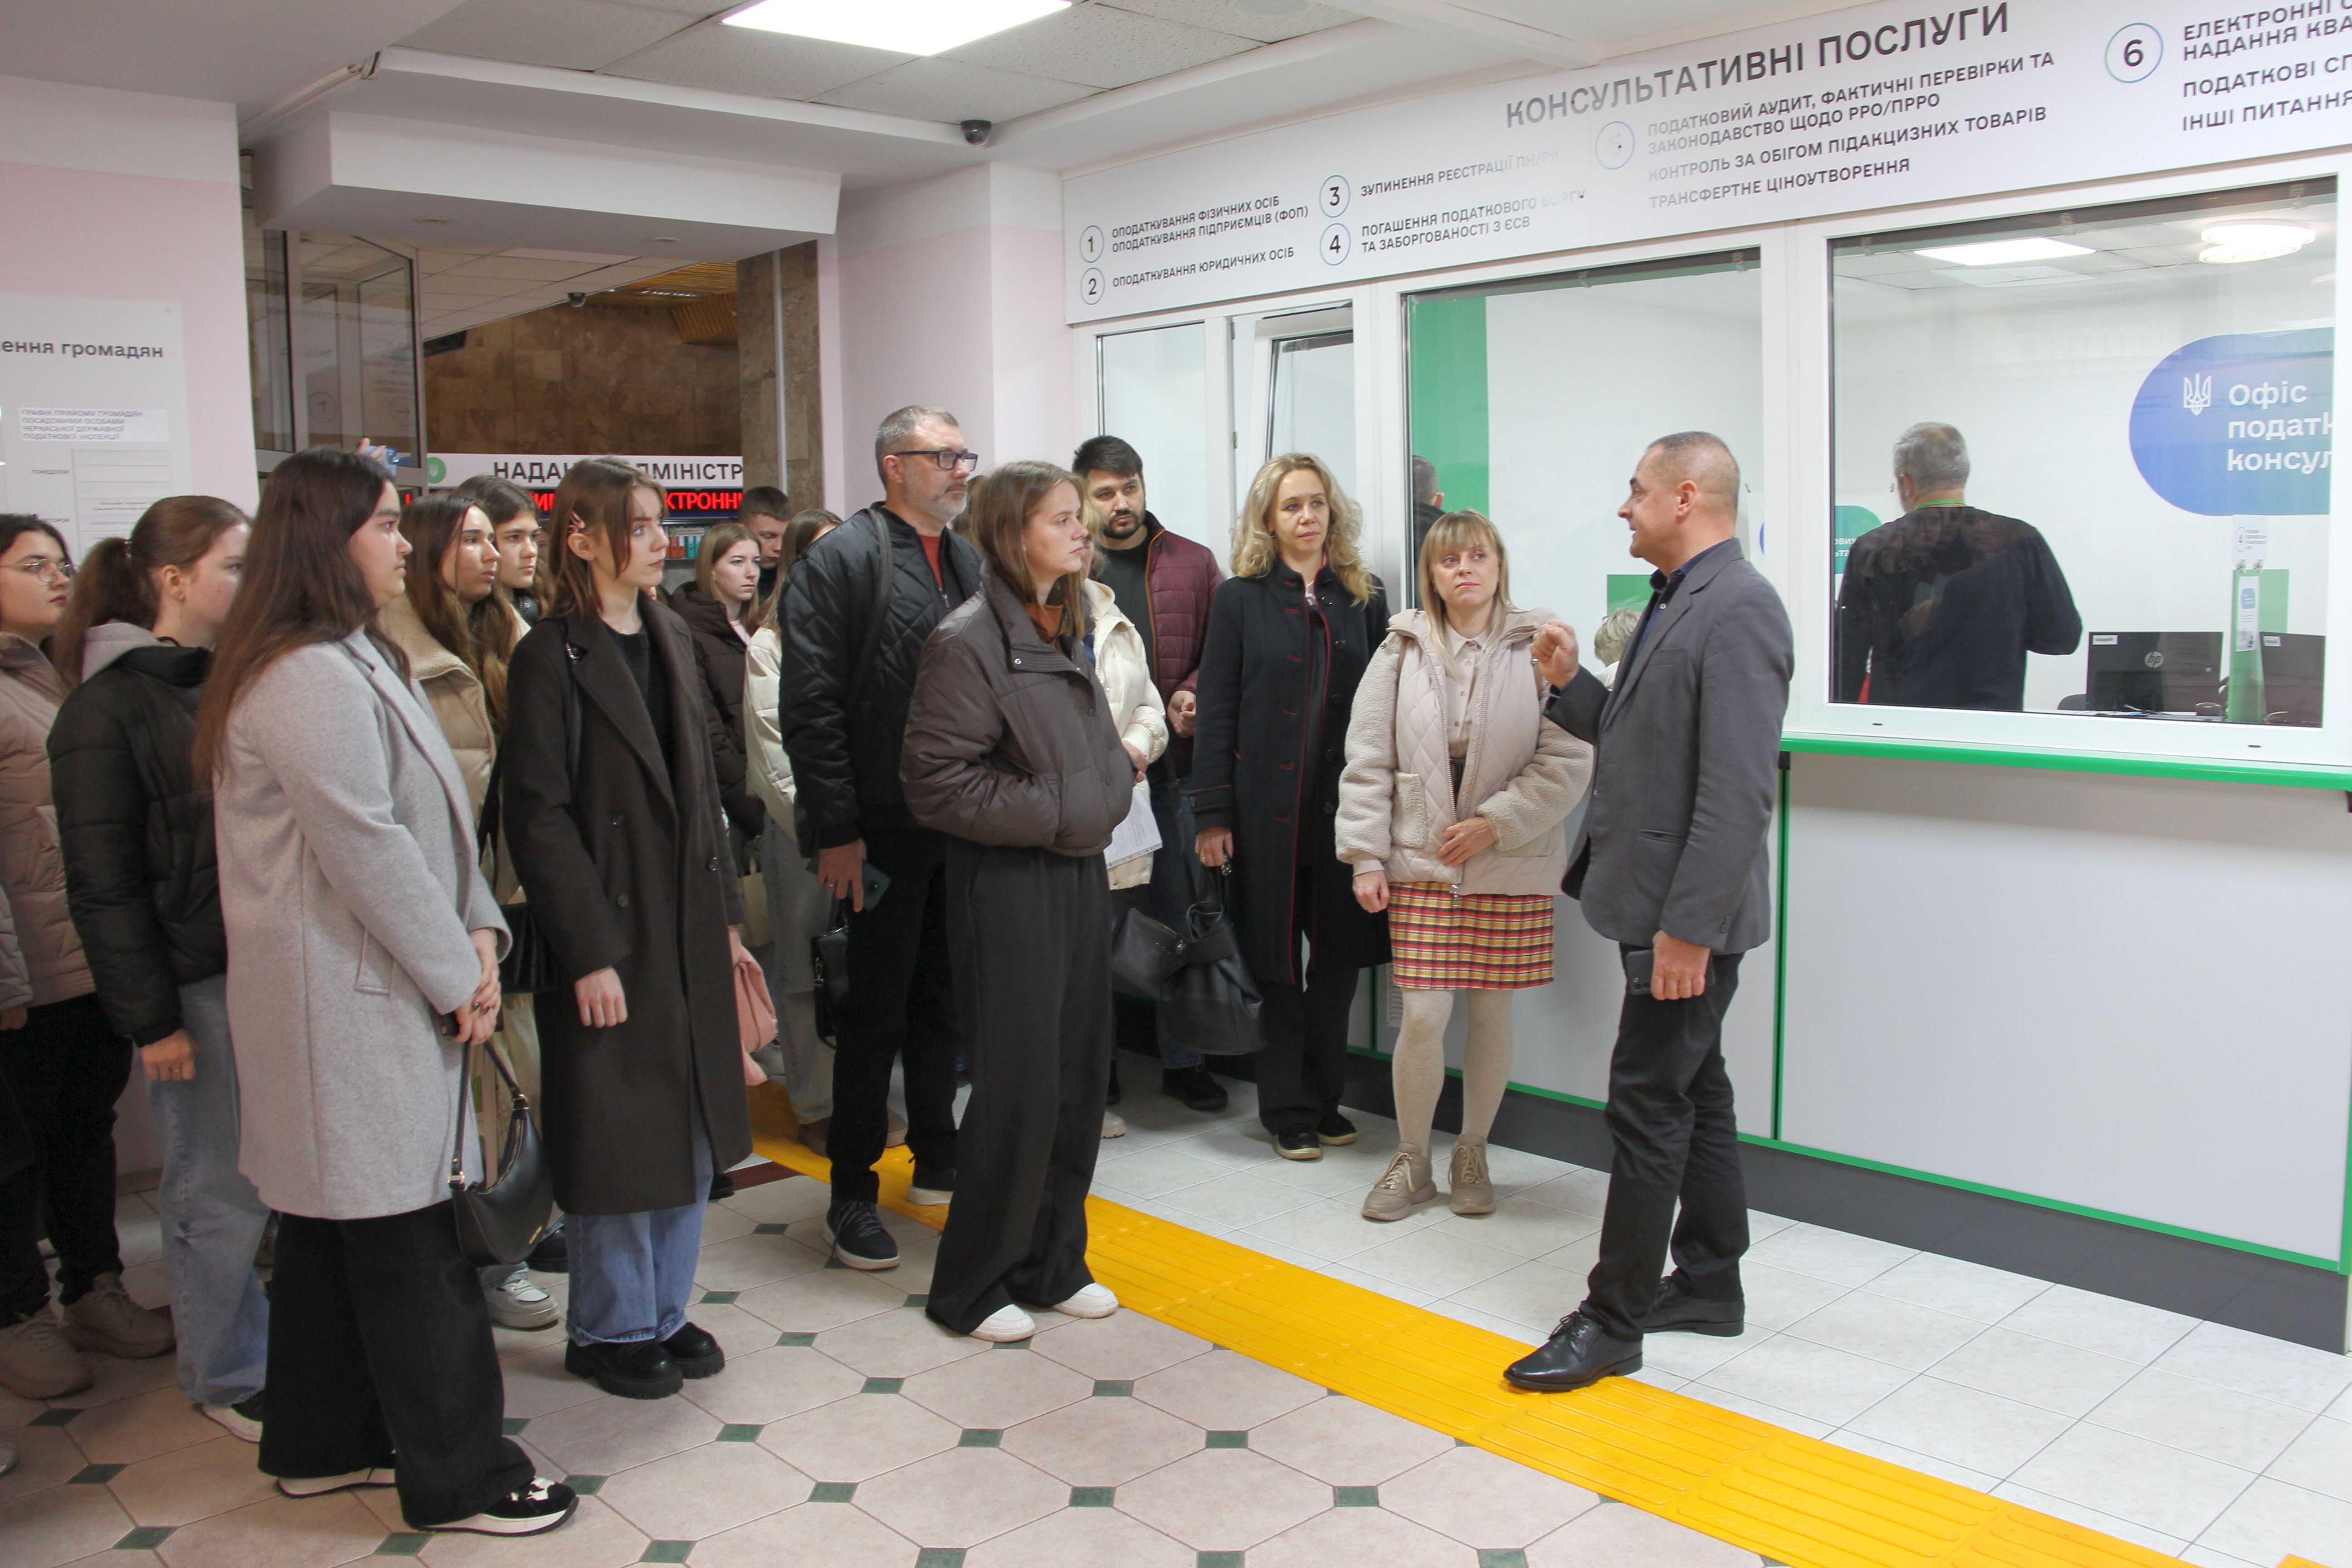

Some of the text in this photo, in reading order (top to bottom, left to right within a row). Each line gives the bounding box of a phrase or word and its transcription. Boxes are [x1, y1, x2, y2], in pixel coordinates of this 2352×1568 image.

[2185, 0, 2330, 40] ЕЛЕКТРОННІ
[2124, 39, 2143, 67] 6
[2185, 26, 2297, 61] НАДАННЯ
[1506, 2, 2008, 128] КОНСУЛЬТАТИВНІ ПОСЛУГИ
[2184, 61, 2314, 97] ПОДАТКОВІ
[1648, 52, 2054, 136] ПОДАТКОВИЙ АУДИТ, ФАКТИЧНІ ПЕРЕВІРКИ ТА
[1648, 93, 1939, 155] ЗАКОНОДАВСТВО ЩОДО РРО/ПРРО
[2184, 109, 2233, 131] ІНШІ
[1649, 107, 2045, 182] КОНТРОЛЬ ЗА ОБІГОМ ПІДАКЦИЗНИХ ТОВАРІВ
[1361, 173, 1433, 196] ЗУПИНЕННЯ
[1439, 155, 1513, 182] РЕЄСТРАЦІЇ
[1649, 158, 1909, 208] ТРАНСФЕРТНЕ ЦІНОУТВОРЕННЯ
[1330, 186, 1339, 206] 3
[1112, 196, 1279, 238] ОПОДАТКУВАННЯ ФІЗИЧНИХ ОСІБ
[1112, 206, 1308, 252] ОПОДАТКУВАННЯ ПІДПРИЄМЦІВ (ФОП)
[1362, 214, 1437, 236] ПОГАШЕННЯ
[1442, 199, 1537, 224] ПОДАТКОВОГО
[1362, 241, 1376, 252] ТА
[1380, 223, 1488, 250] ЗАБОРГОВАНОСТІ
[1505, 216, 1530, 230] ЄСВ
[1330, 235, 1341, 254] 4
[1113, 247, 1294, 287] ОПОДАТКУВАННЯ ЮРИДИЧНИХ ОСІБ
[1089, 278, 1097, 295] 2
[61, 343, 163, 359] громадян
[2228, 380, 2308, 409] Офіс
[494, 462, 568, 483] НАДА
[2146, 652, 2162, 668] hp
